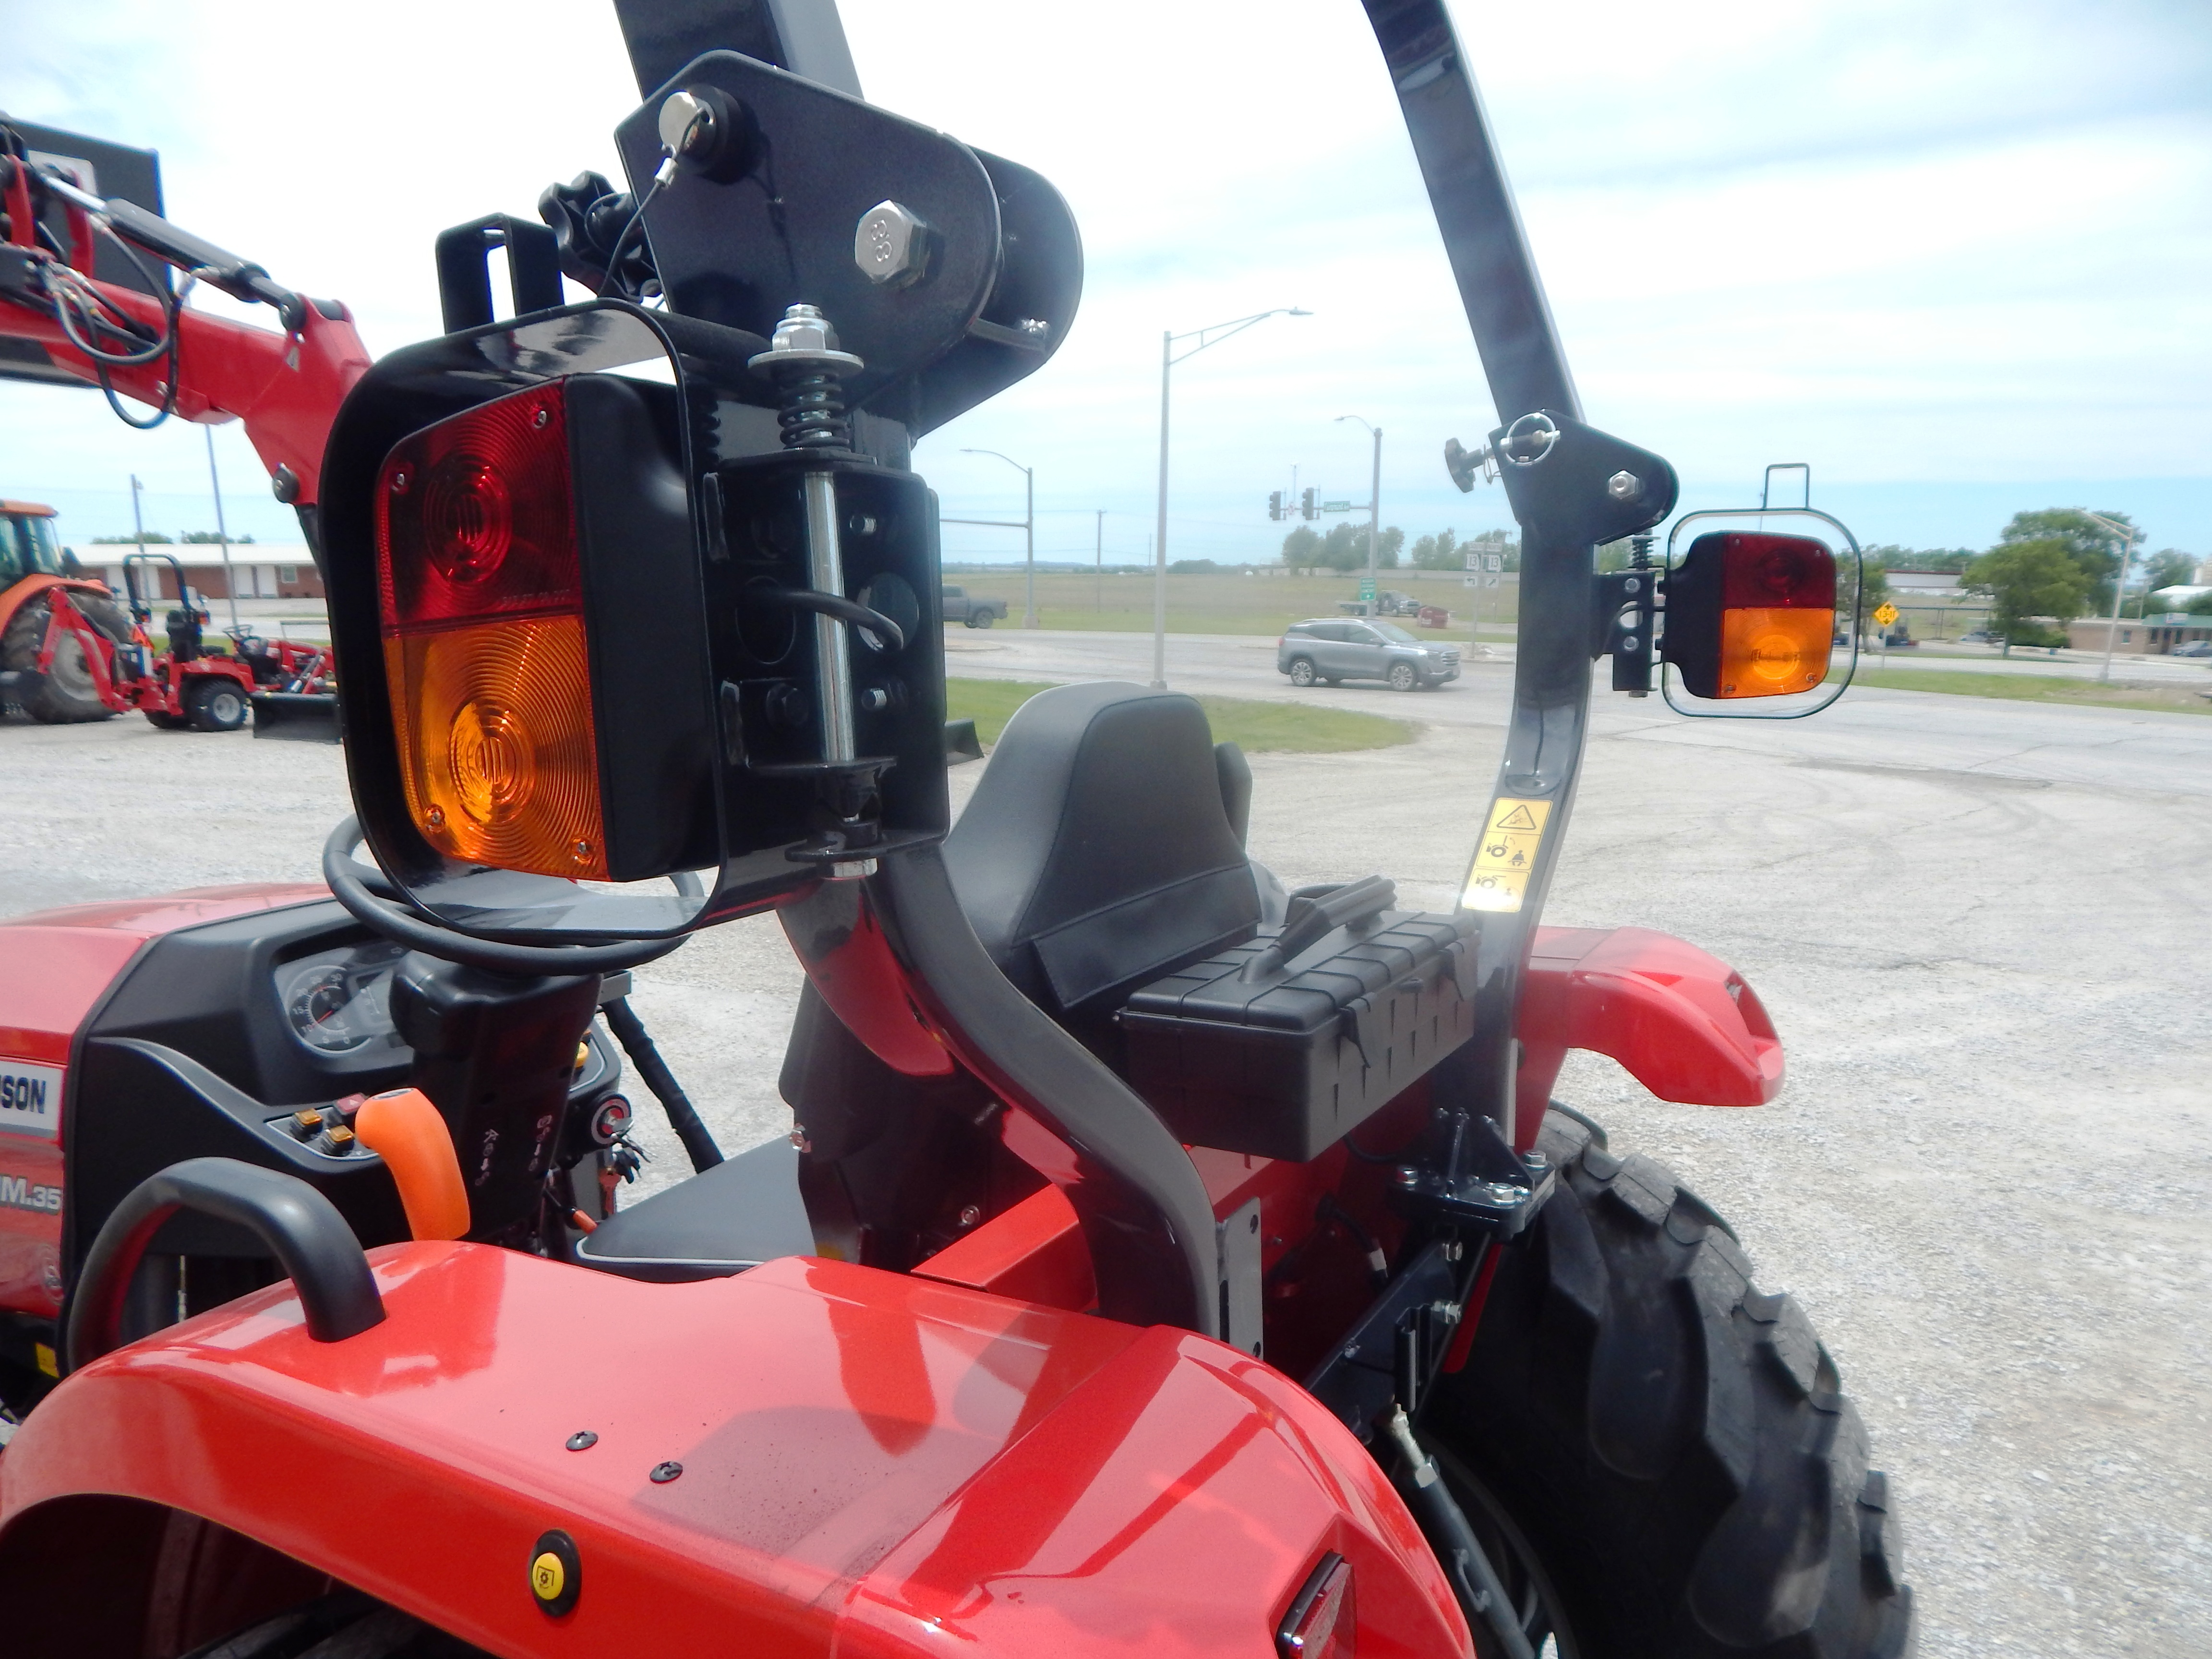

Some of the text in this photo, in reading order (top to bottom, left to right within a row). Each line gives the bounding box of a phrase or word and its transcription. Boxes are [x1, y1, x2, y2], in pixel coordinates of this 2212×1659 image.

[1469, 556, 1477, 566] 13
[1491, 557, 1499, 567] 13
[0, 1074, 47, 1114] SON
